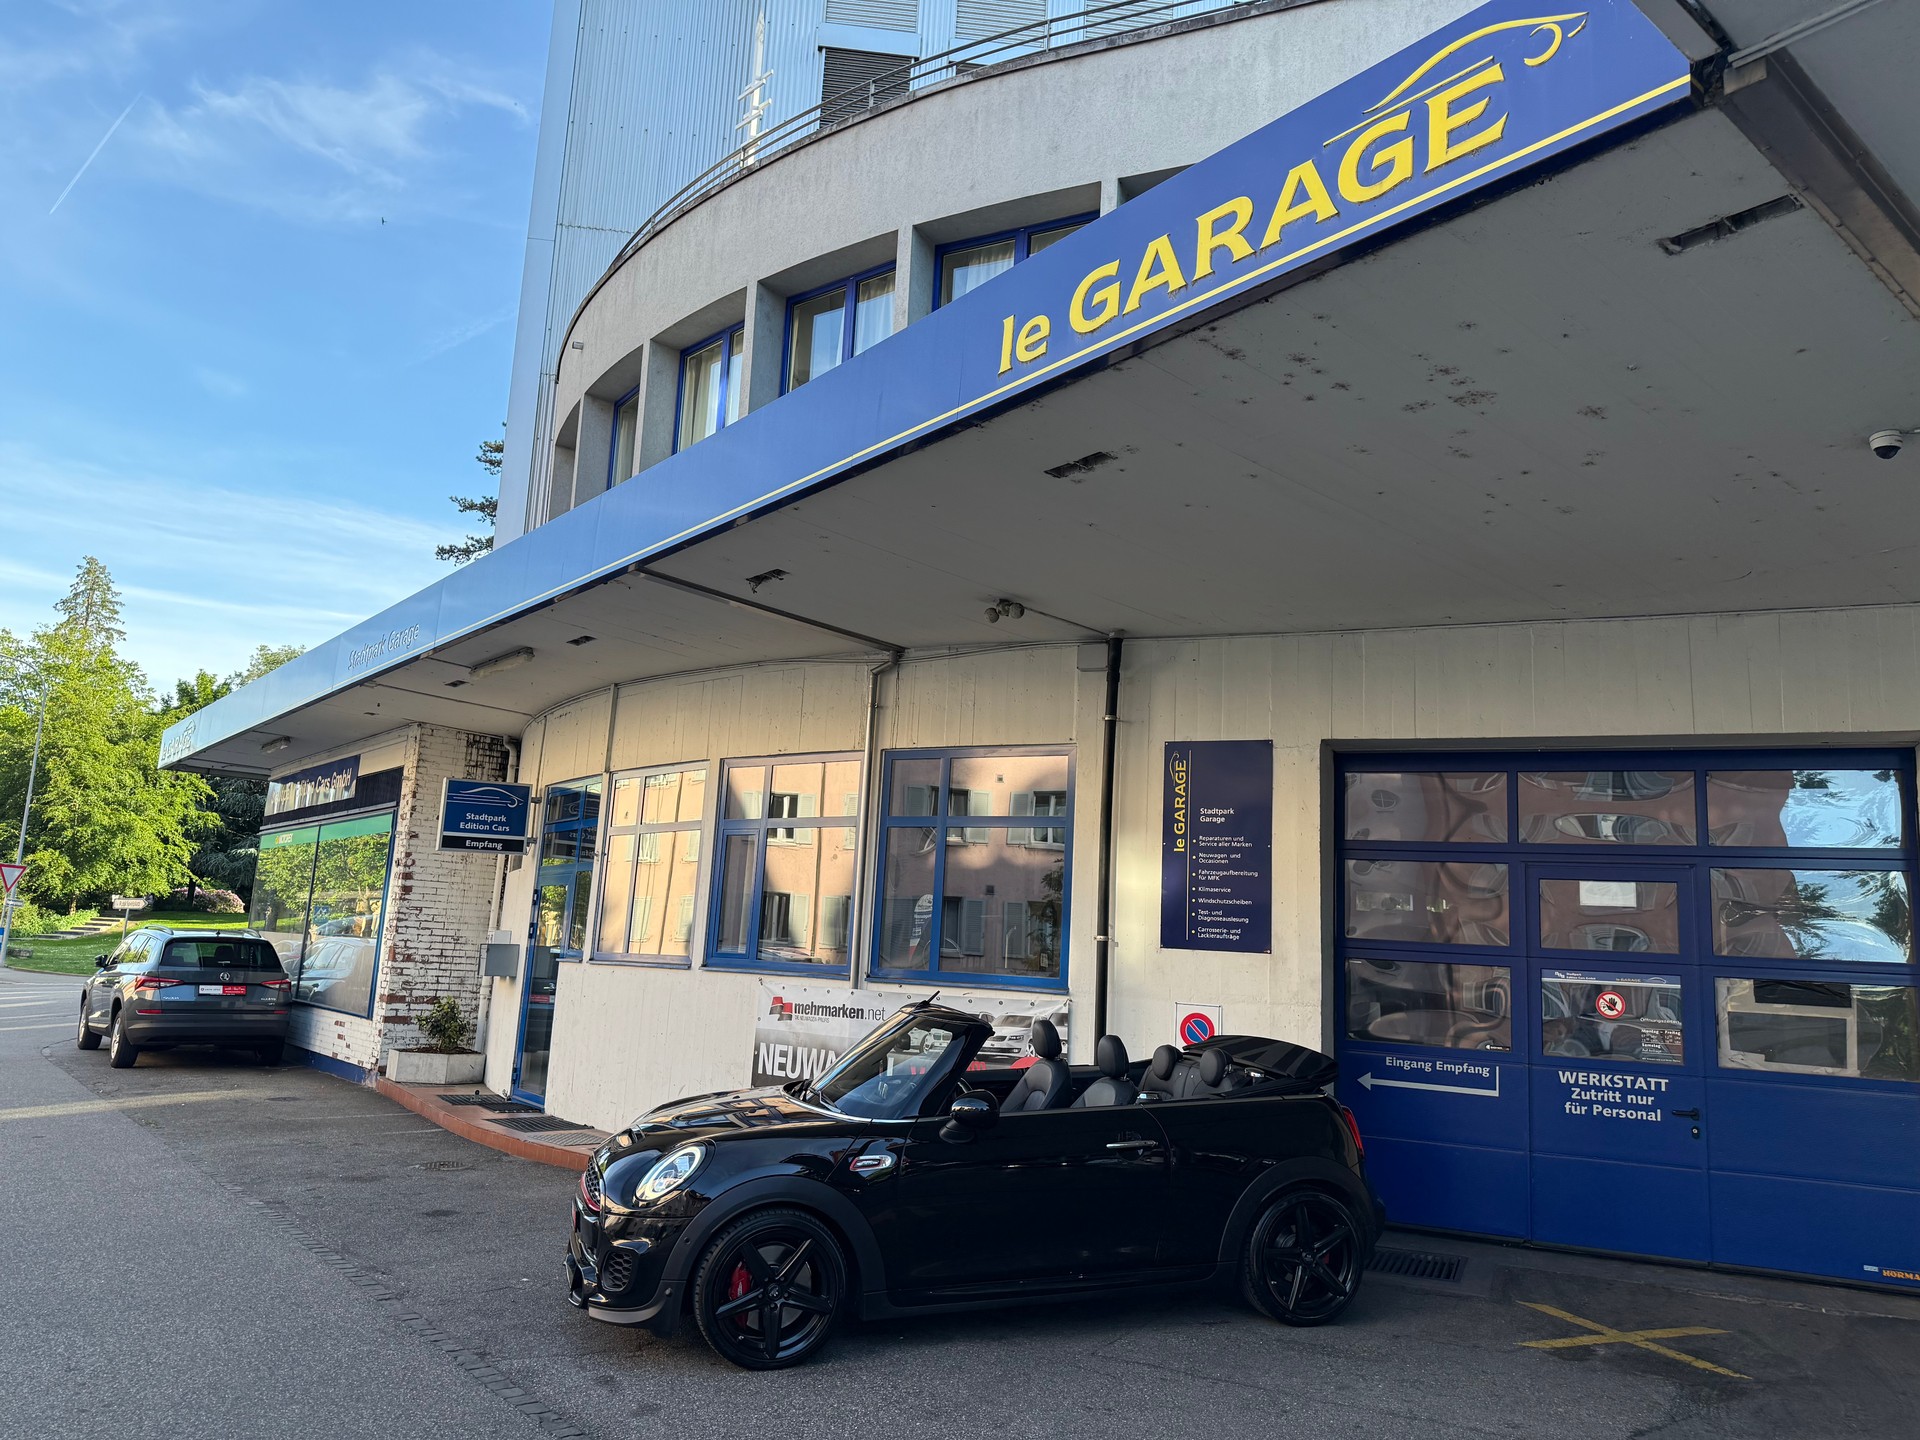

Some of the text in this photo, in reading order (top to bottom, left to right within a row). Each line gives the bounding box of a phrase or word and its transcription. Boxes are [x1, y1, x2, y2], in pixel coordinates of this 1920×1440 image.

[998, 62, 1508, 377] le GARAGE
[347, 623, 420, 671] Stadtpark Garage
[1173, 759, 1187, 852] le GARAGE
[1200, 807, 1235, 816] Stadtpark
[466, 812, 507, 823] Stadtpark
[1200, 815, 1226, 824] Garage
[459, 821, 510, 832] Edition Cars
[465, 839, 503, 850] Empfang
[1199, 852, 1228, 860] Neuwagen
[1198, 869, 1259, 878] Fahrzeugaufbereitung
[1198, 915, 1249, 924] Diagnoseauslesung
[1198, 932, 1240, 941] Lackieraufträge
[794, 1001, 886, 1021] mehrmarken.net
[1385, 1056, 1490, 1078] Eingang Empfang
[1558, 1070, 1669, 1092] WERKSTATT
[1571, 1087, 1655, 1106] Zutritt nur
[1564, 1101, 1661, 1122] für Personal
